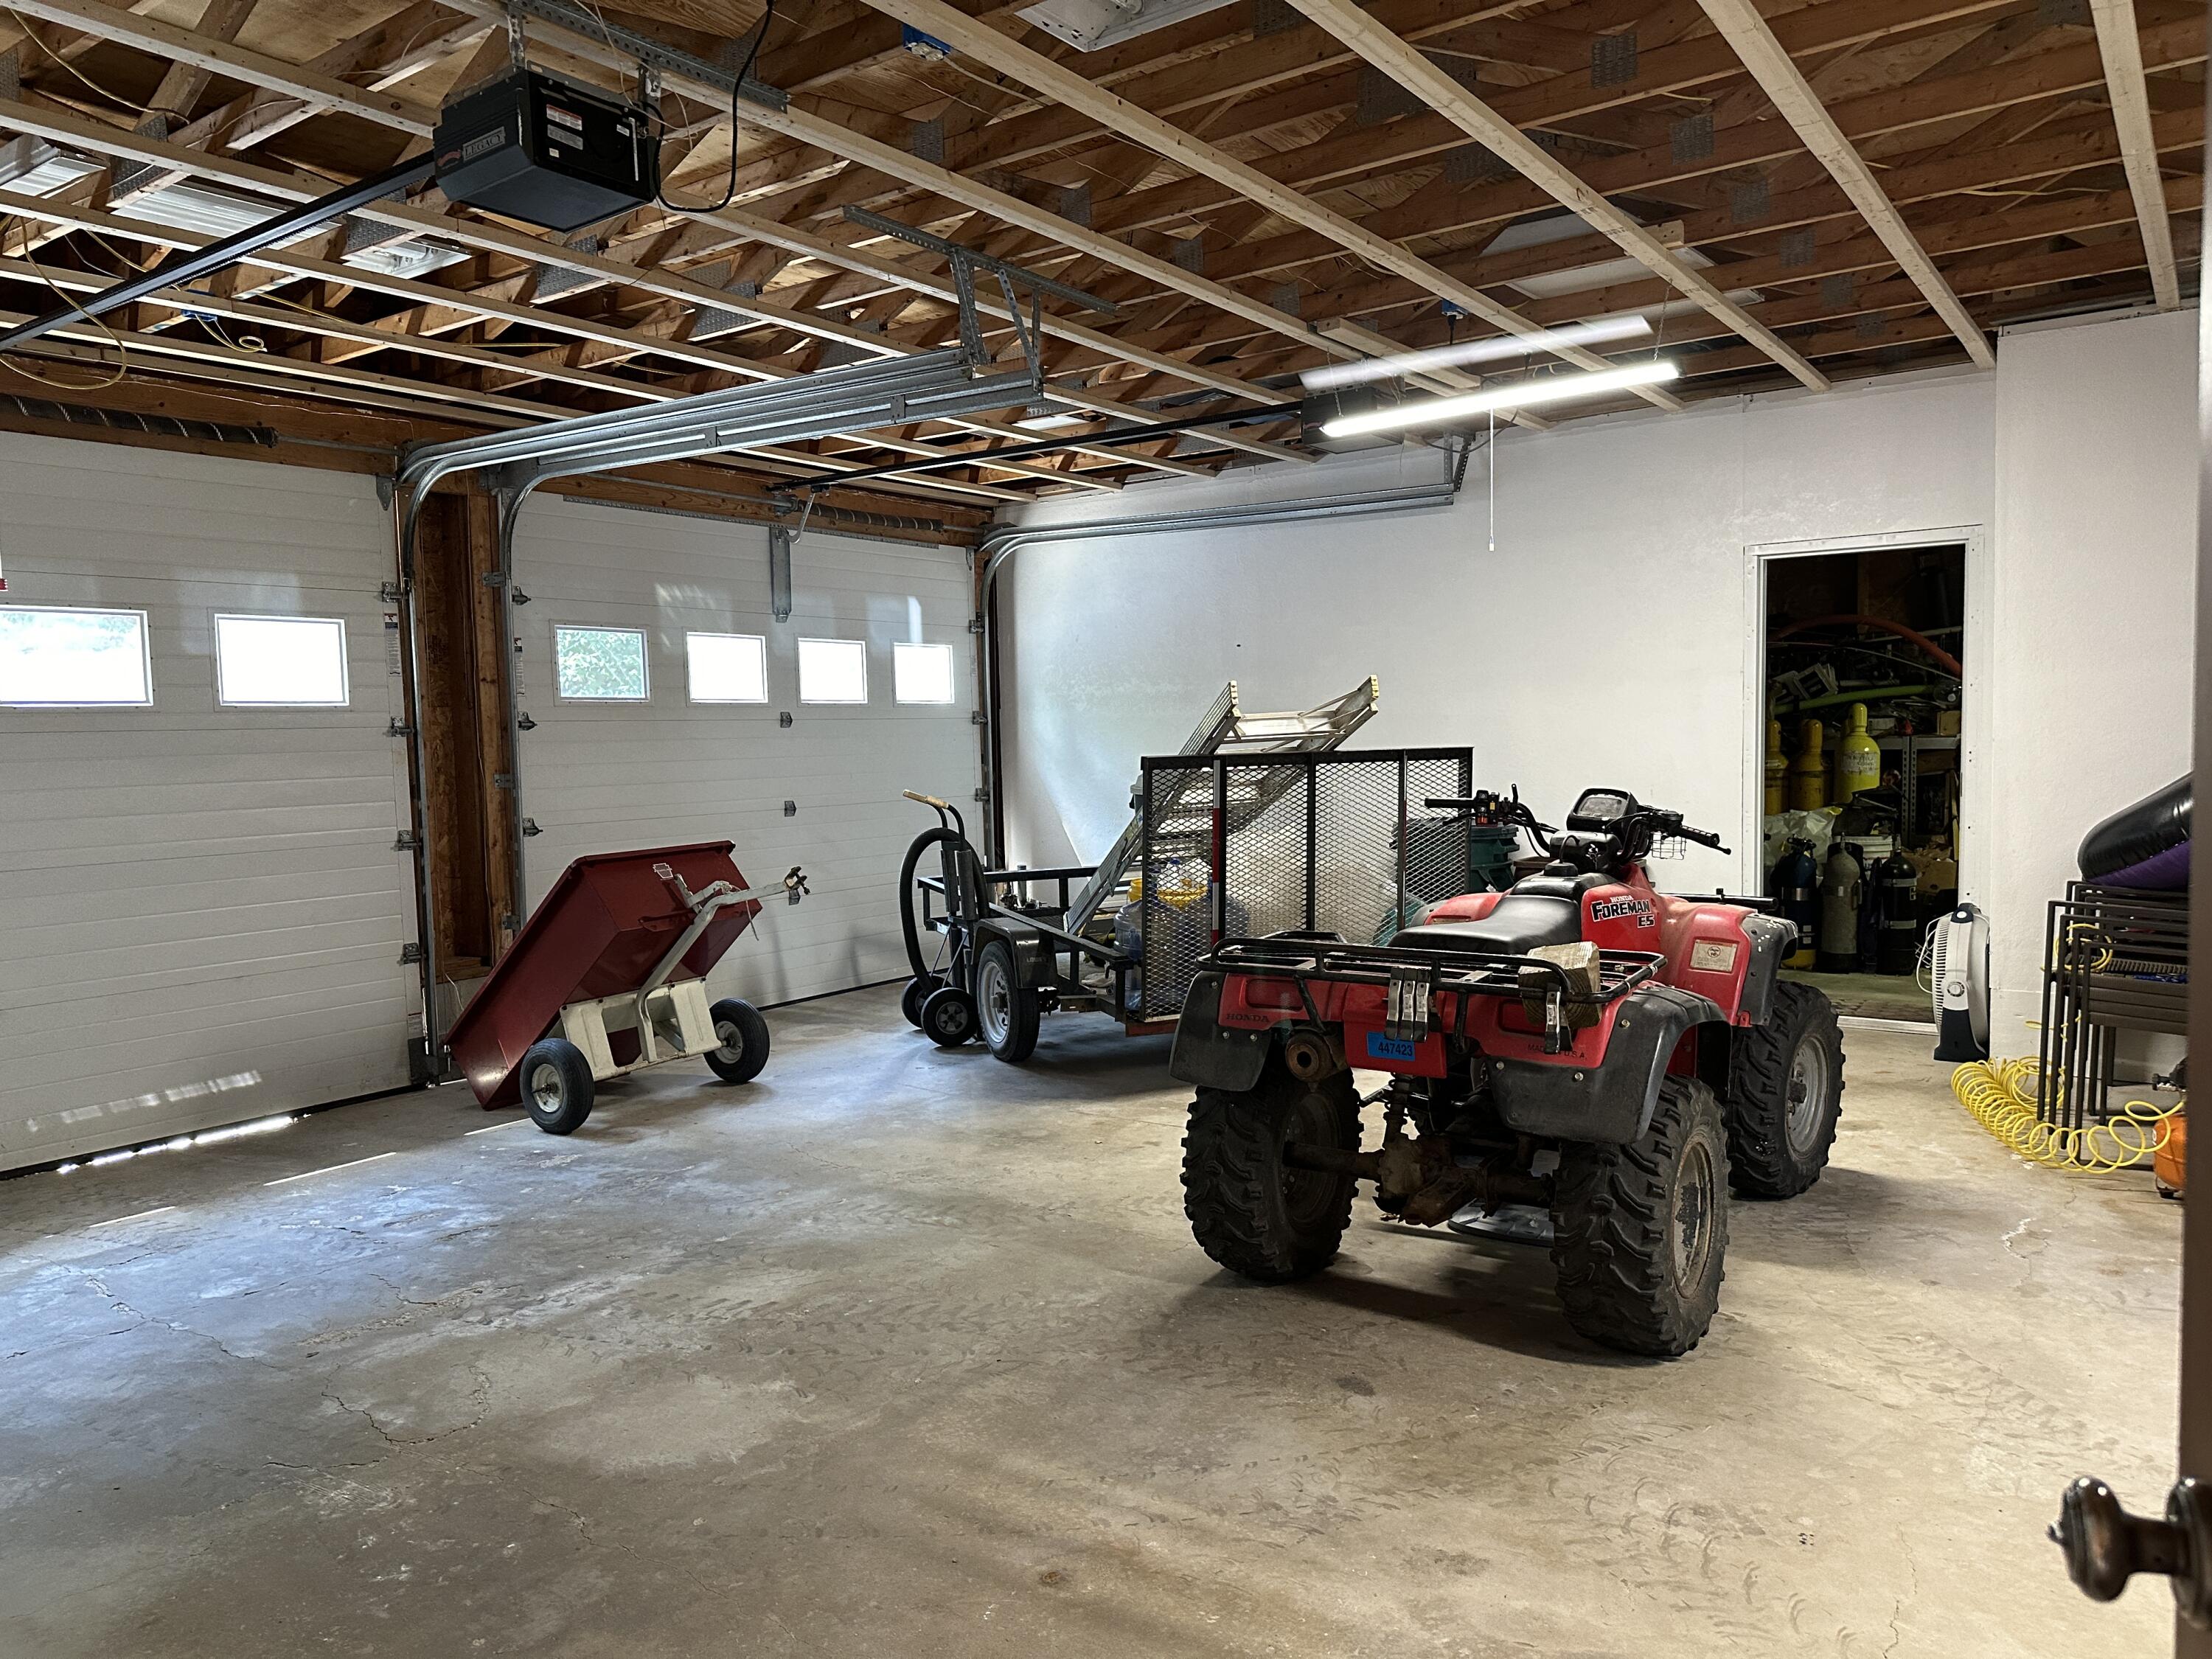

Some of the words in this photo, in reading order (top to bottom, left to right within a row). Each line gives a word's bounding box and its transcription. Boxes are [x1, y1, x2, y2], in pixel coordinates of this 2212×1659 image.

[465, 133, 502, 156] LEGACY
[1610, 895, 1634, 903] HONDA
[1590, 900, 1652, 922] FOREMAN
[1637, 914, 1655, 928] ES
[1226, 1013, 1270, 1023] HONDA
[1377, 1042, 1413, 1056] 447423
